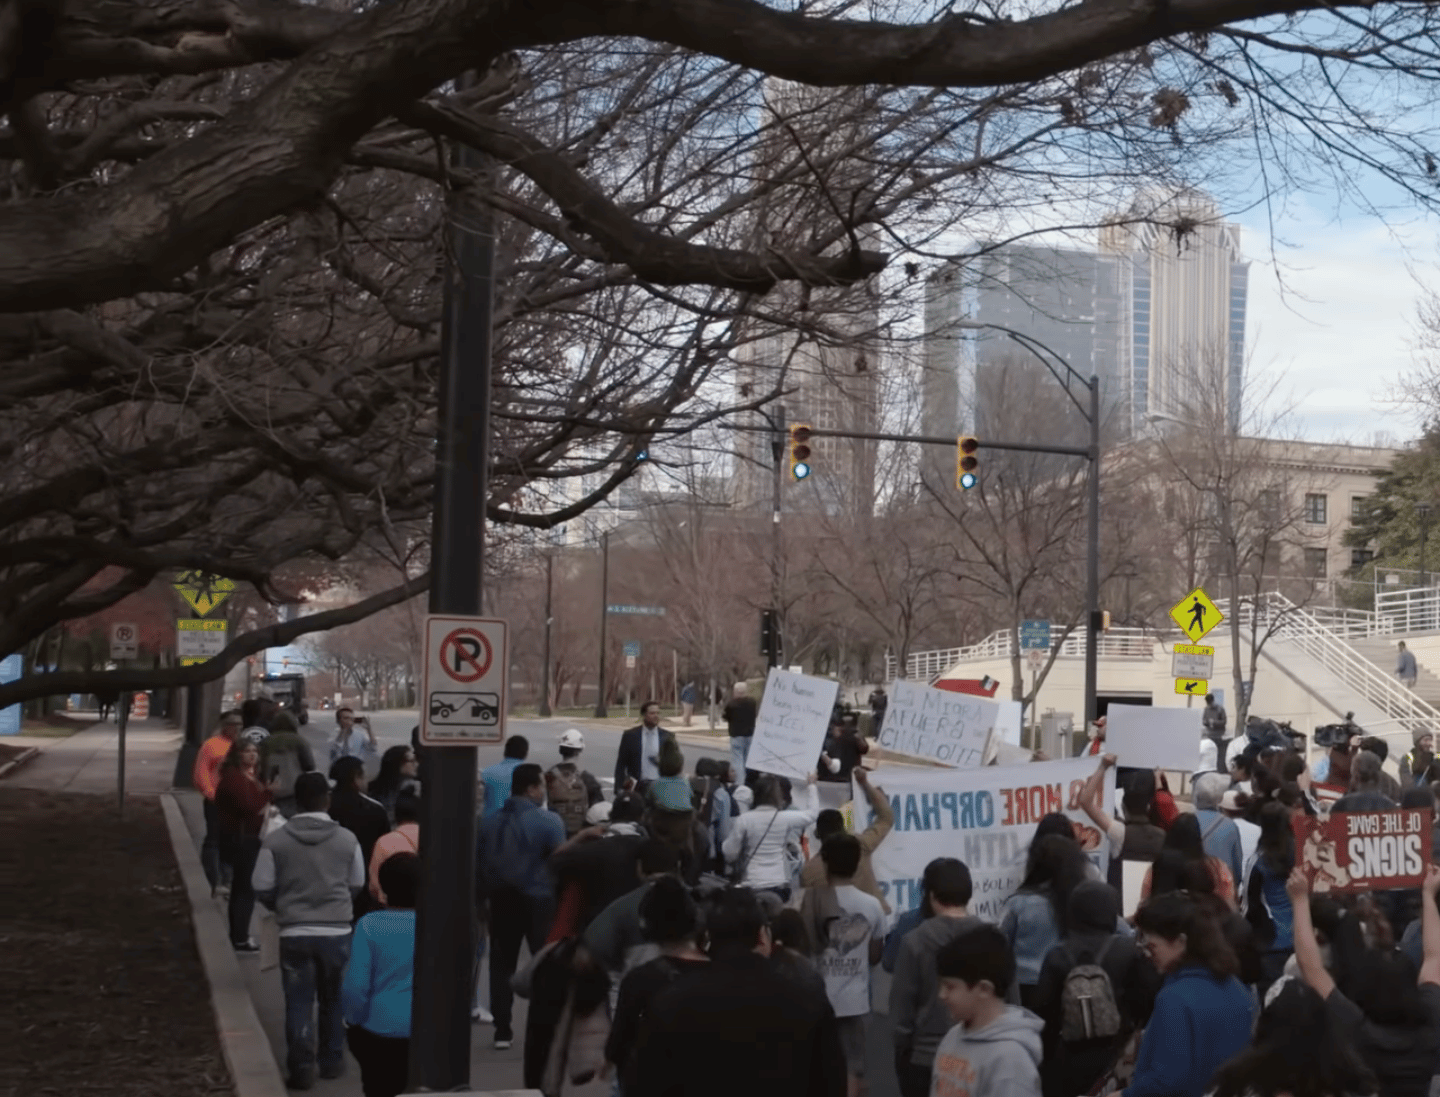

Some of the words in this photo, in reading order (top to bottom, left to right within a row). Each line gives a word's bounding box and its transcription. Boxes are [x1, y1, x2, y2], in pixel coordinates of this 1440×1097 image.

[1347, 815, 1380, 835] GAME
[1382, 814, 1404, 834] THE
[1406, 812, 1421, 832] OF
[1349, 834, 1423, 879] SIGNS
